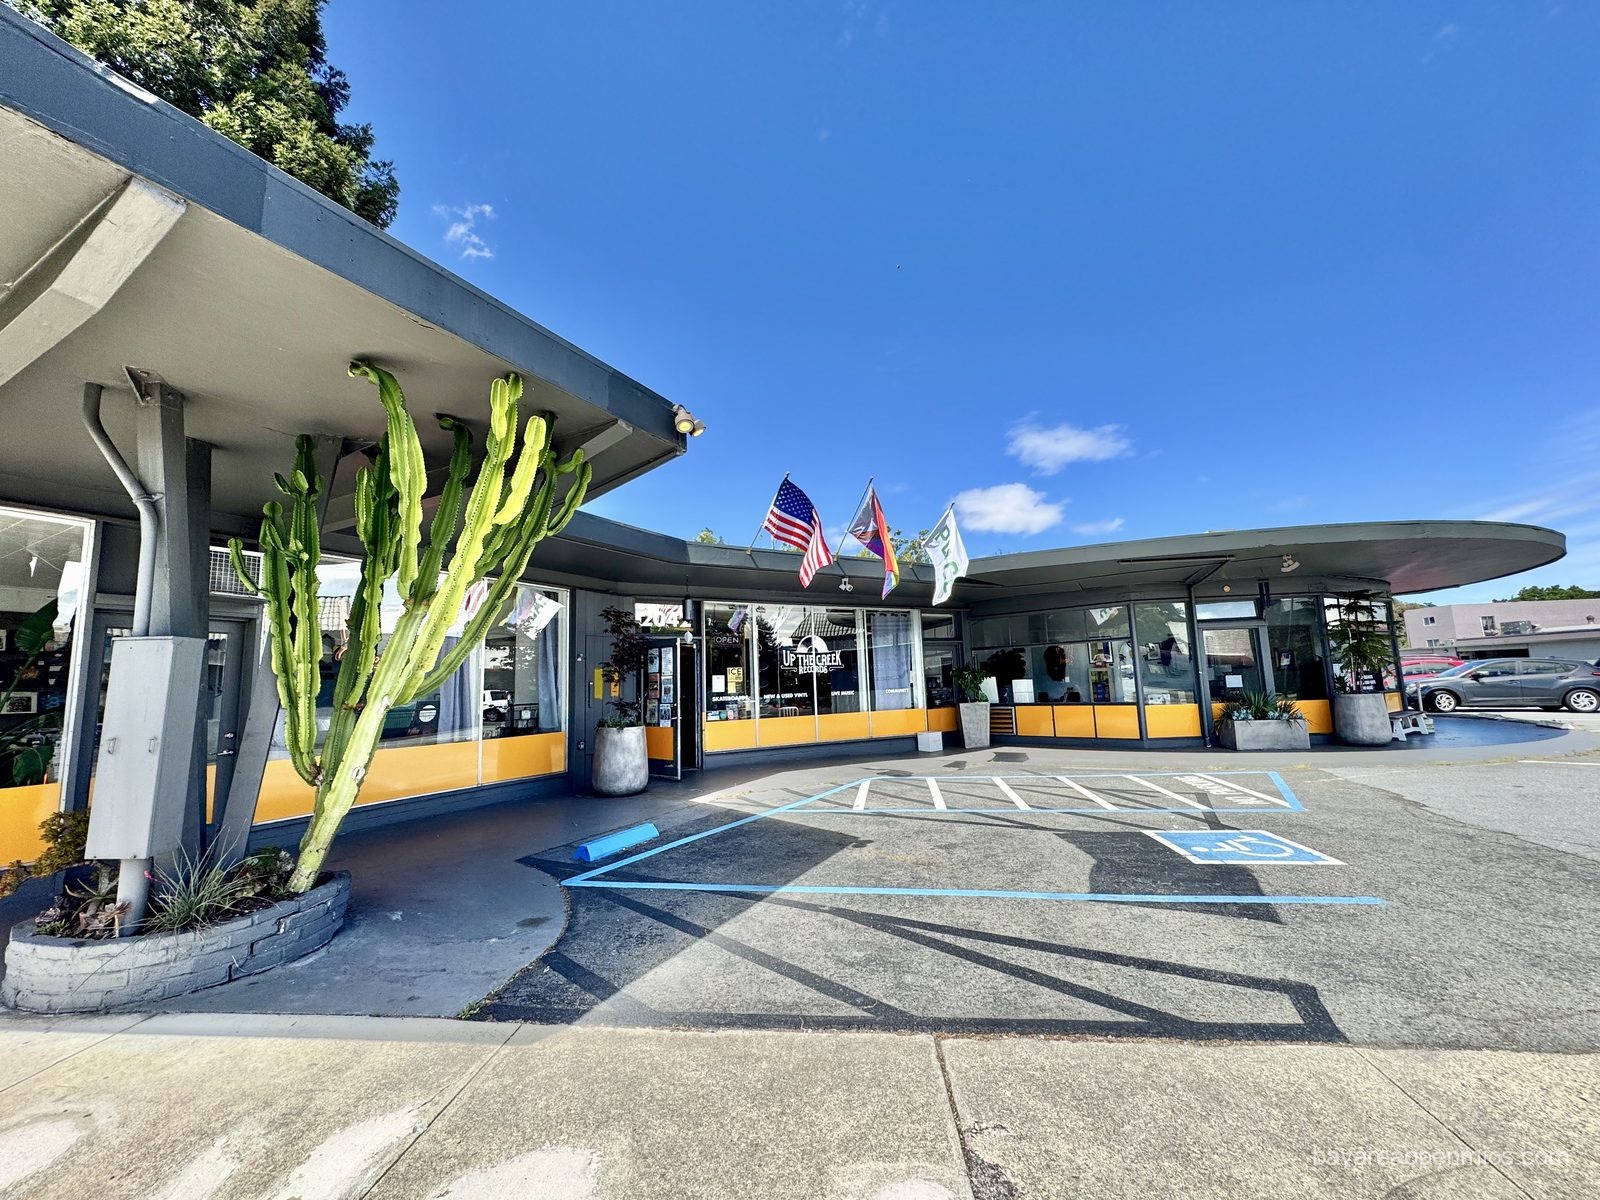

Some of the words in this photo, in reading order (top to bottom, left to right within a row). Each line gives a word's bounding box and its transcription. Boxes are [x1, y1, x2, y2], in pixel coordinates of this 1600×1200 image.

[782, 650, 797, 667] UP
[797, 653, 815, 666] THE
[815, 650, 842, 666] CREEK
[798, 665, 828, 675] RECORDS
